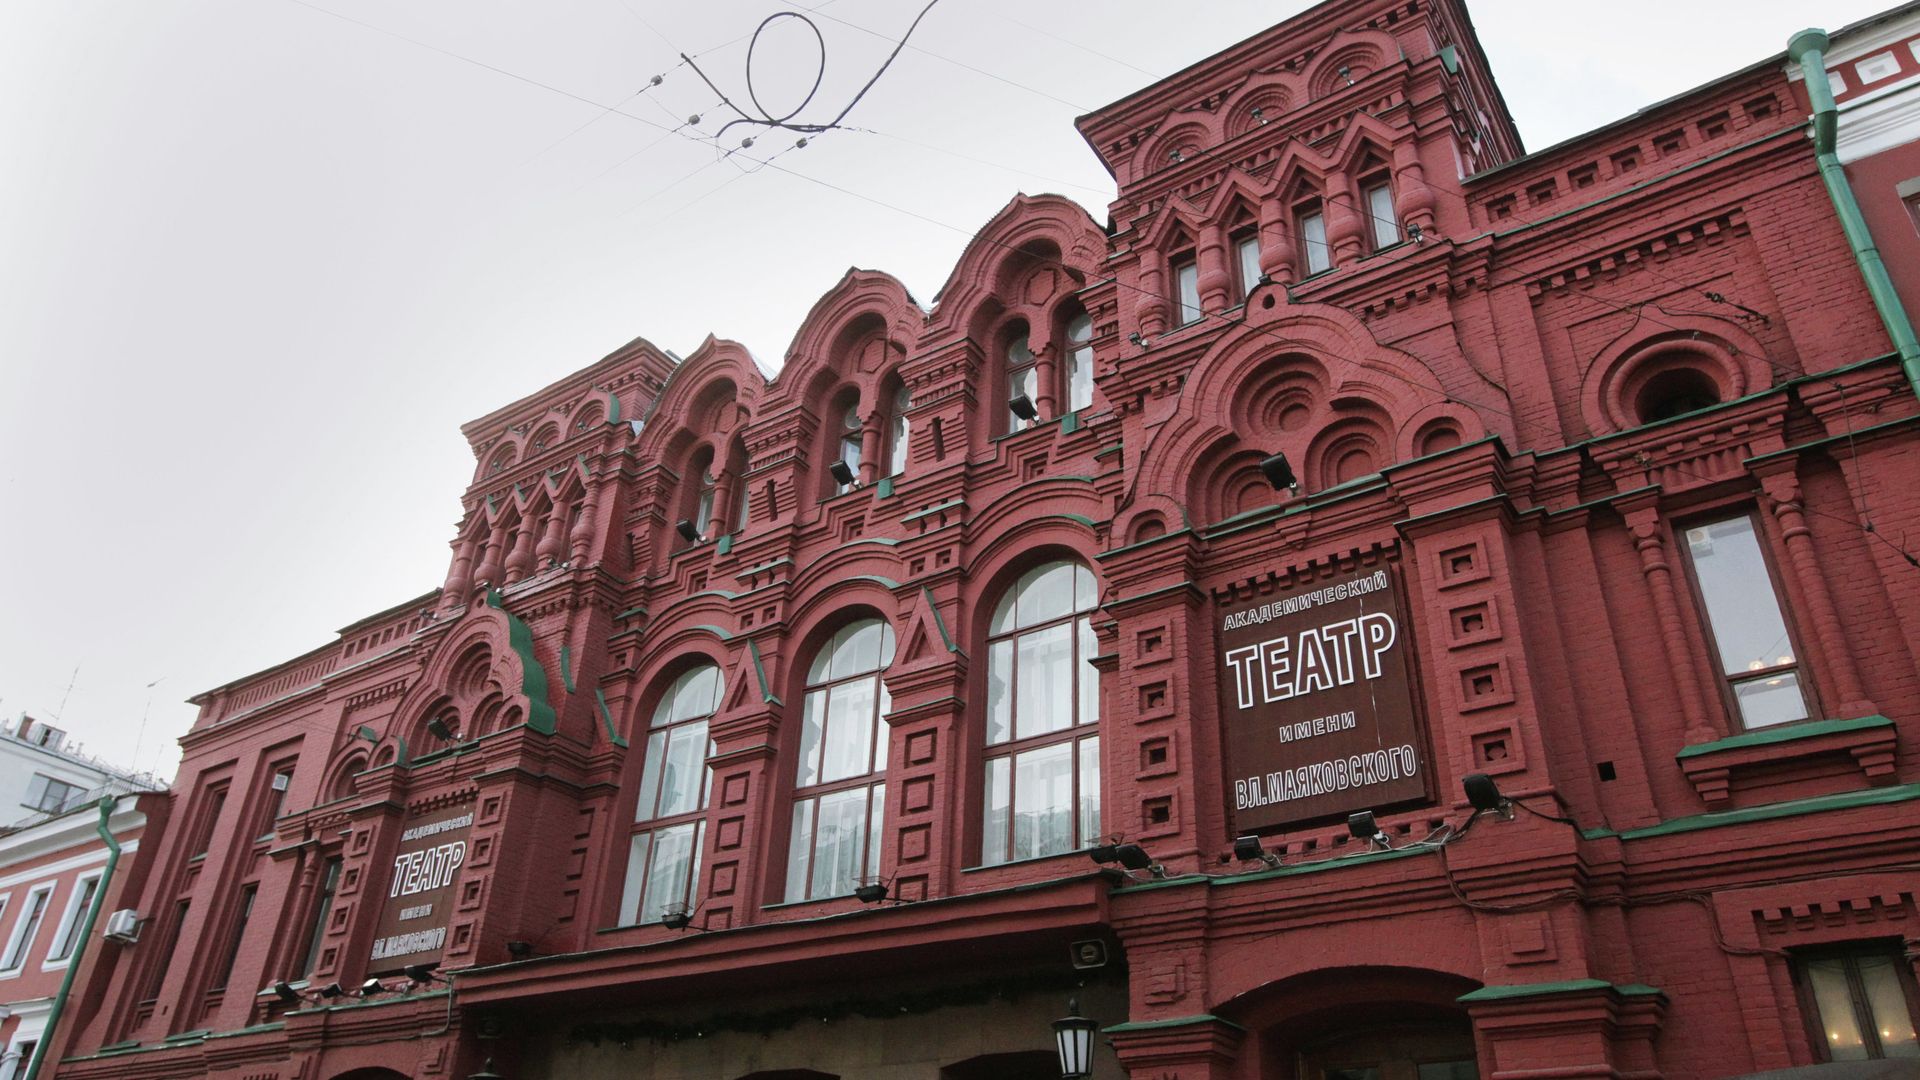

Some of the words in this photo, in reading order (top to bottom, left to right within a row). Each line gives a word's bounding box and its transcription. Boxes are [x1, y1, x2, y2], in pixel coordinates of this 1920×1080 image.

[1224, 571, 1388, 630] АКАДЕМИЧЕСКИЙ
[1226, 612, 1396, 709] ТЕАТР
[1279, 711, 1356, 743] ИМЕНИ
[1235, 744, 1417, 810] ВЛ.МАЯКОВСКОГО
[390, 841, 466, 898] ТЕАТР
